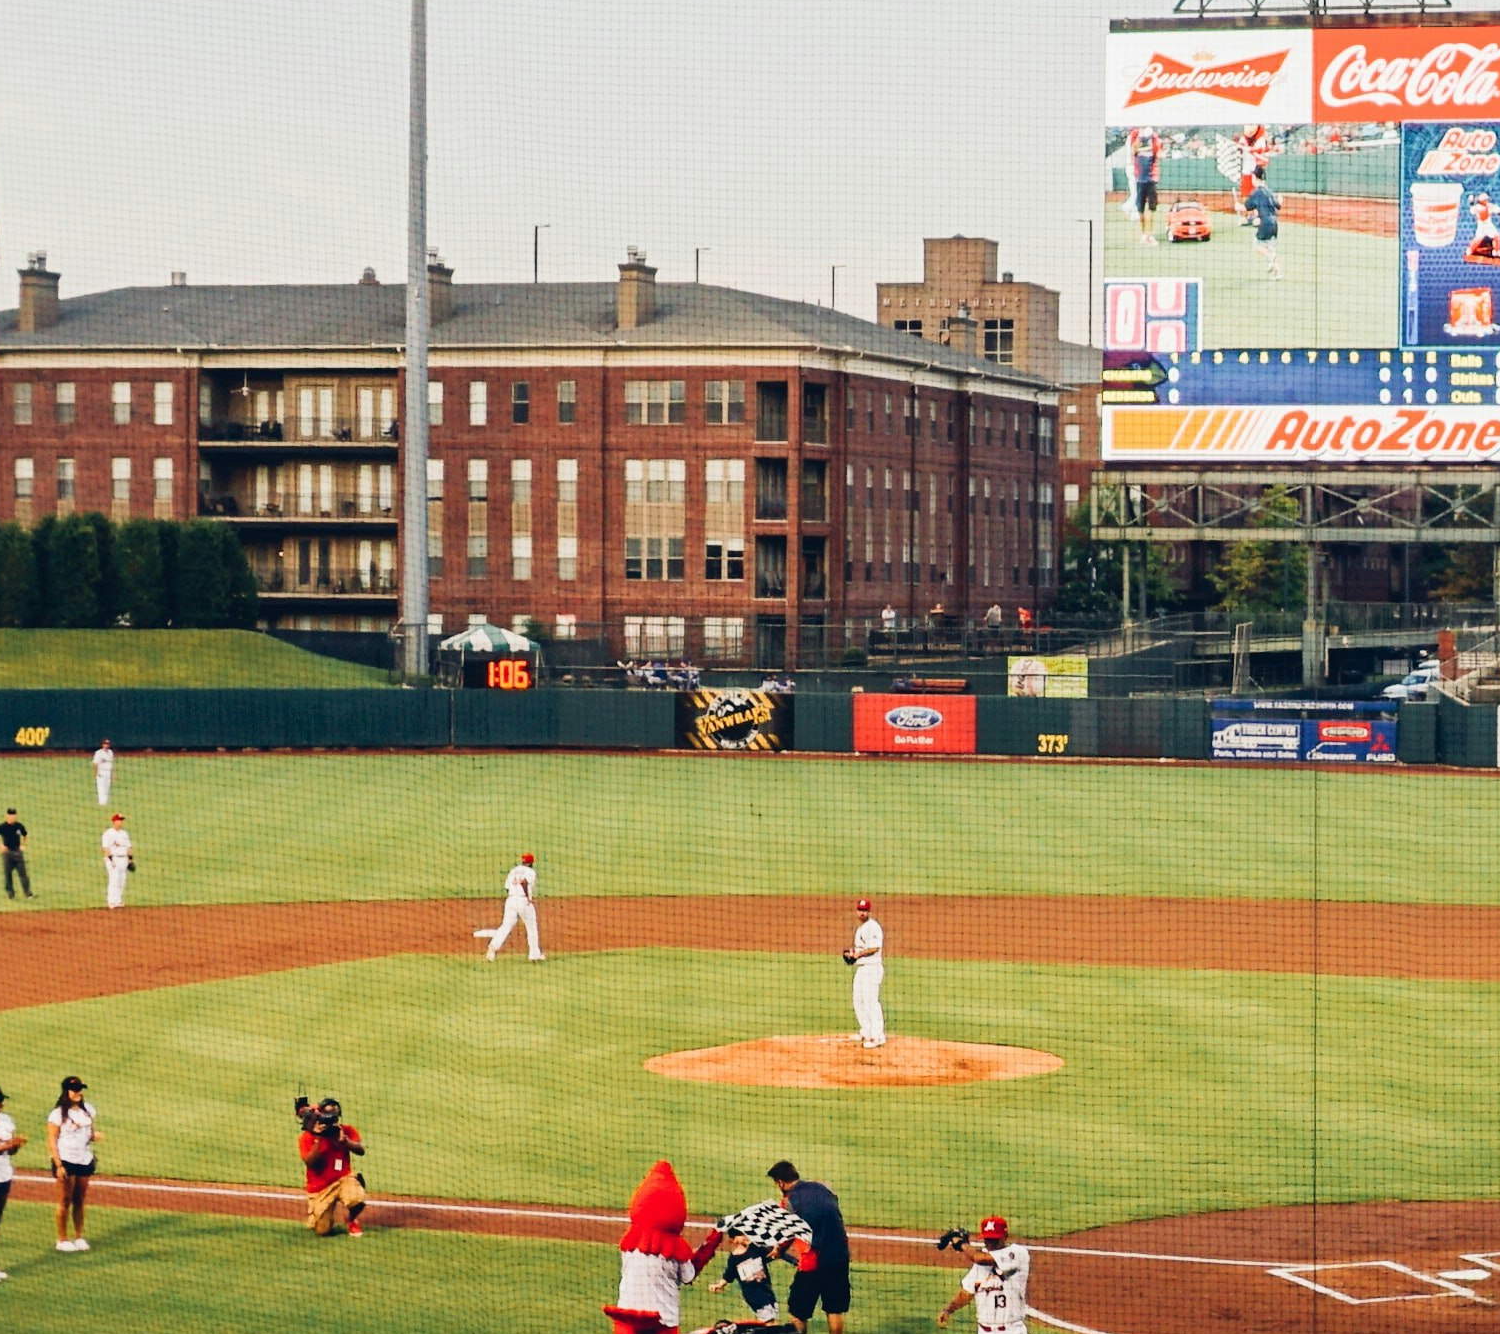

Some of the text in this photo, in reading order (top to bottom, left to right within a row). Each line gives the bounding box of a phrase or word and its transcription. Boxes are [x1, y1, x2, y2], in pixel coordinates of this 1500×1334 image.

[1130, 61, 1287, 94] Budweiser
[1443, 129, 1494, 149] Auto
[1443, 152, 1498, 171] Zone
[1170, 351, 1179, 364] 1
[1238, 351, 1250, 364] 4
[1306, 351, 1318, 364] 7
[1450, 354, 1483, 368] Balls
[1450, 373, 1495, 386] Strikes
[1450, 391, 1482, 404] Outs
[487, 660, 529, 689] 1:06
[896, 708, 932, 727] Ford
[1037, 733, 1069, 754] 373'
[1236, 749, 1262, 758] Service
[994, 1294, 1007, 1309] 13
